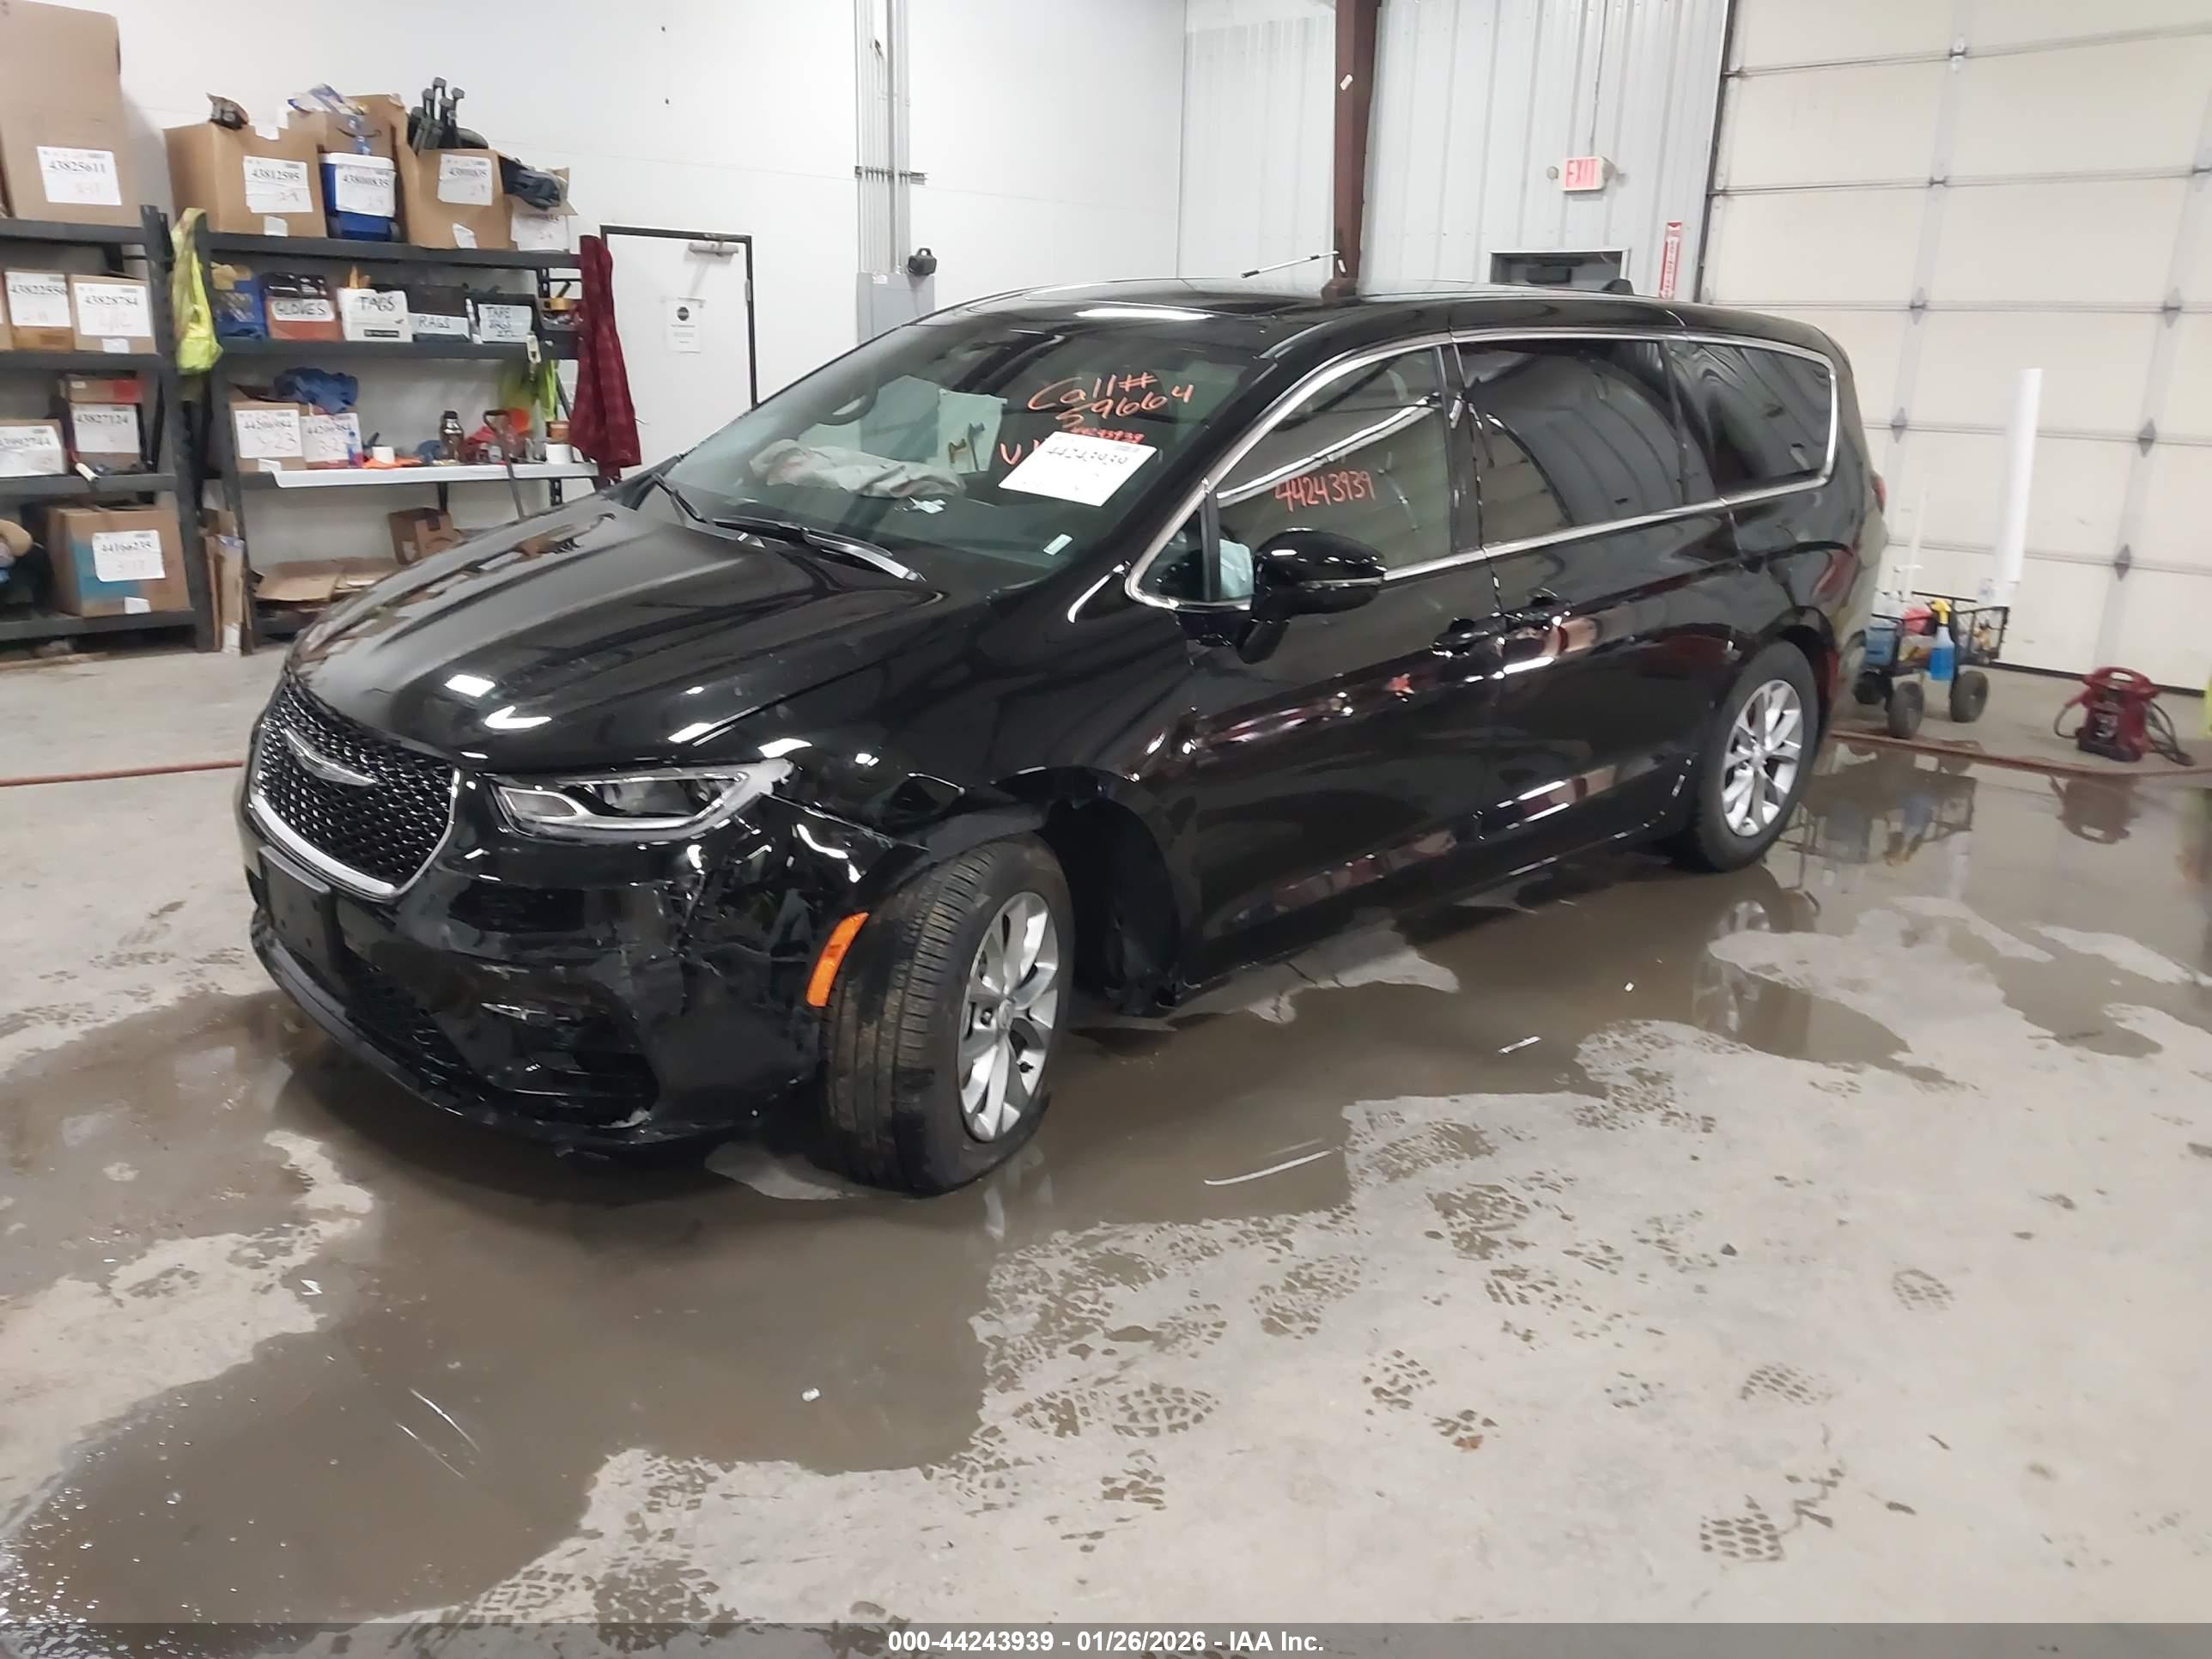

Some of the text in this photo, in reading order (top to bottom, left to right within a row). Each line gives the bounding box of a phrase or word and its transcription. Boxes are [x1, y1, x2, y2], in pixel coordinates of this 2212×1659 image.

[1565, 159, 1597, 187] EXIT
[274, 302, 327, 315] GLOVES
[358, 296, 396, 312] TAGS
[419, 316, 451, 329] RAGS
[1274, 471, 1376, 513] 44243939
